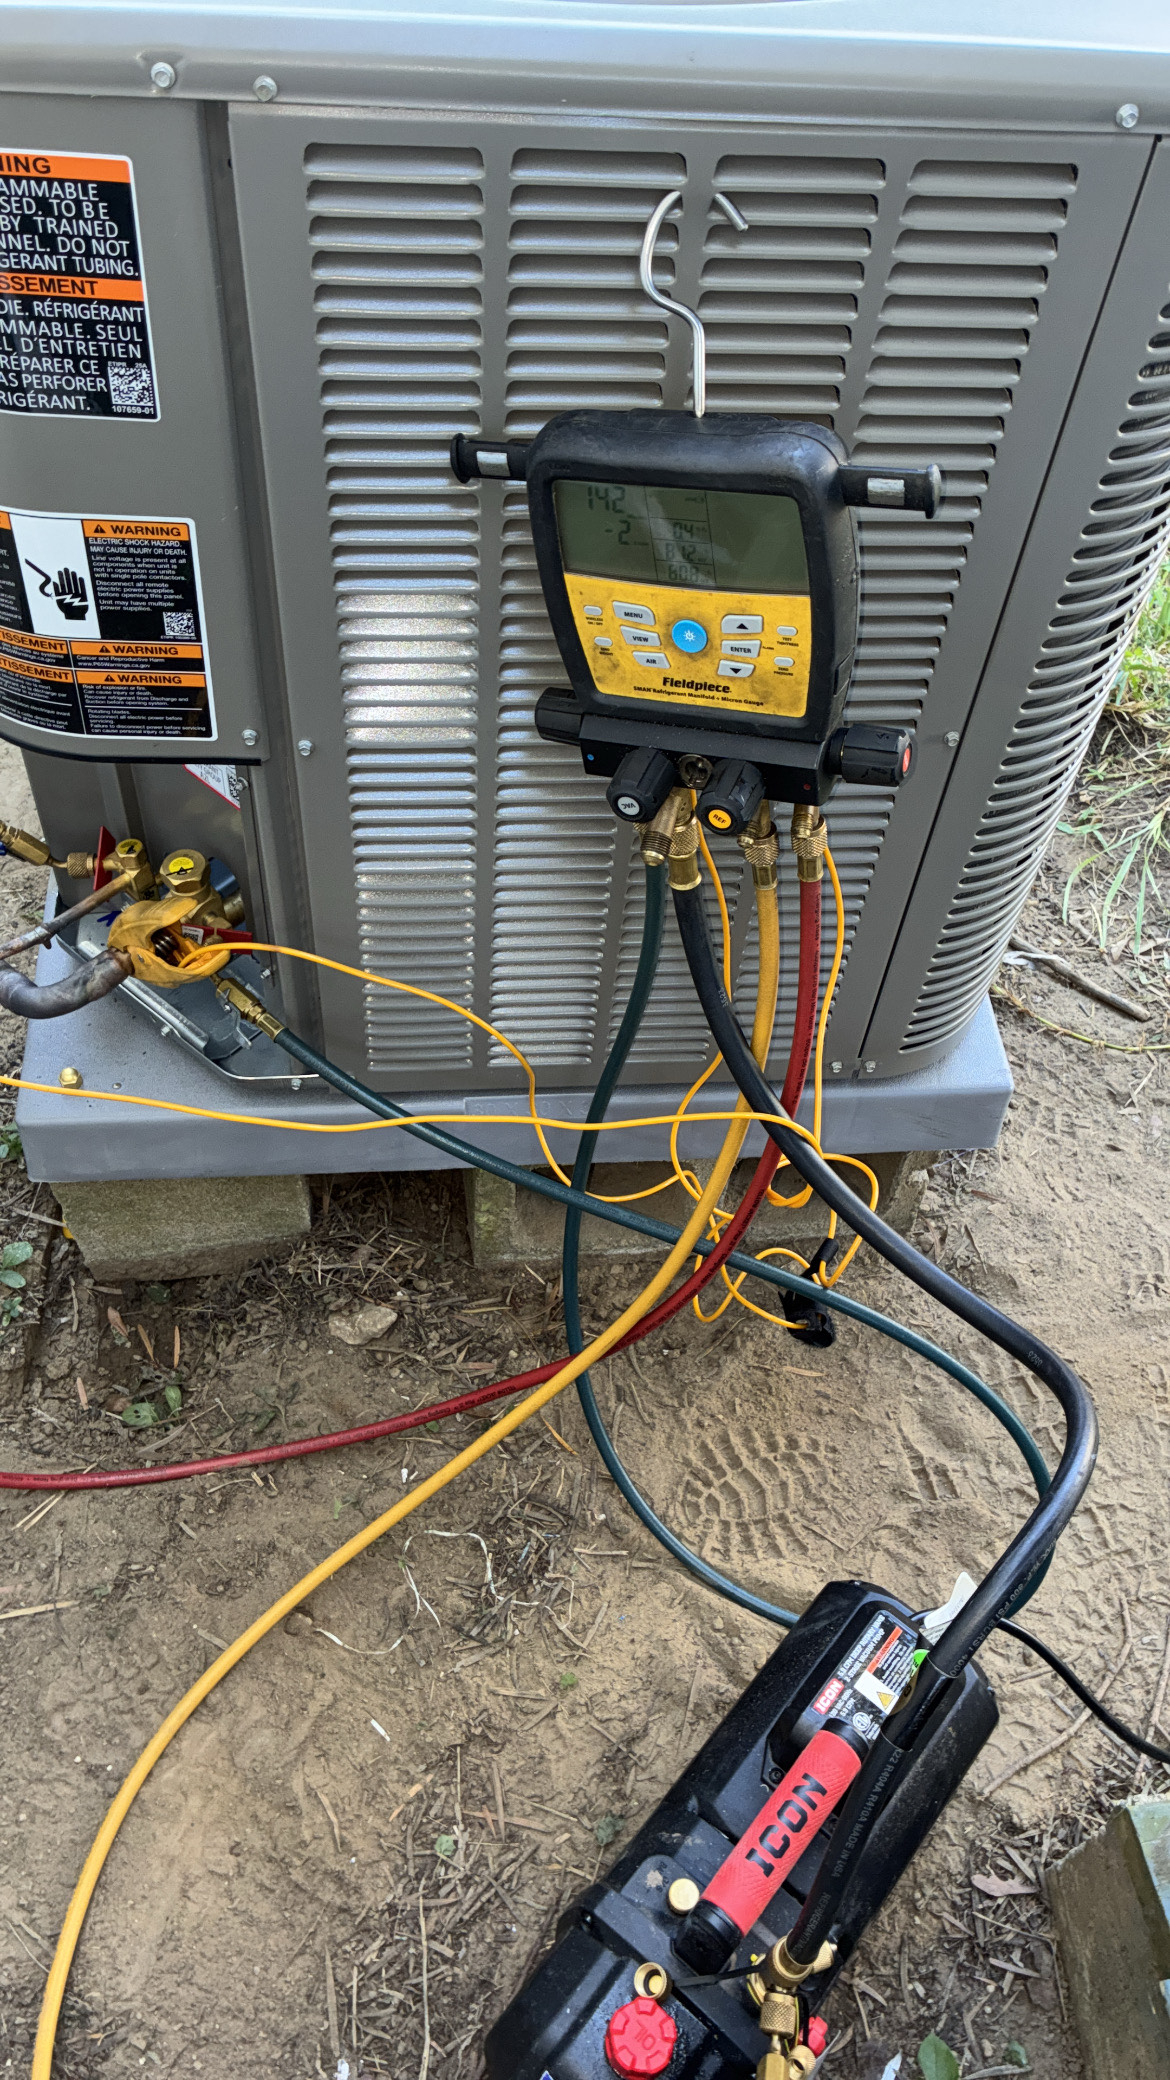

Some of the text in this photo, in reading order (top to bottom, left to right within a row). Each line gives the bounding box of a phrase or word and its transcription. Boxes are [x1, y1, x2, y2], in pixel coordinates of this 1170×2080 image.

[0, 196, 42, 216] SED.
[49, 199, 76, 217] TO
[0, 215, 118, 238] BY TRAINED
[57, 236, 86, 254] DO
[92, 238, 130, 257] NOT
[71, 256, 139, 276] TUBING.
[33, 298, 143, 323] RÉFRIGÉRANT
[96, 324, 143, 342] SEUL
[79, 359, 100, 374] CE
[22, 373, 108, 392] PERFORER
[112, 405, 154, 414] 107659-01
[587, 486, 626, 513] 142
[110, 524, 181, 537] WARNING
[88, 538, 123, 546] ELECTRIC
[150, 540, 182, 548] HAZARD.
[128, 547, 151, 555] INJURY
[624, 611, 643, 619] MENU
[0, 630, 66, 652] ISSEMENT
[112, 645, 179, 656] WARNING
[730, 646, 752, 654] ENTER
[0, 657, 70, 680] TISSEMENT
[117, 674, 182, 684] WARNING
[662, 677, 731, 693] Fieldpiece
[652, 688, 687, 698] Refrigerant
[687, 692, 715, 700] Manifold
[621, 802, 636, 810] VAC
[712, 813, 727, 824] REF
[872, 1628, 885, 1642] PUMP
[815, 1680, 841, 1711] ICON
[744, 1772, 828, 1878] ICON
[844, 1823, 862, 1848] MADE
[831, 1860, 845, 1877] USA
